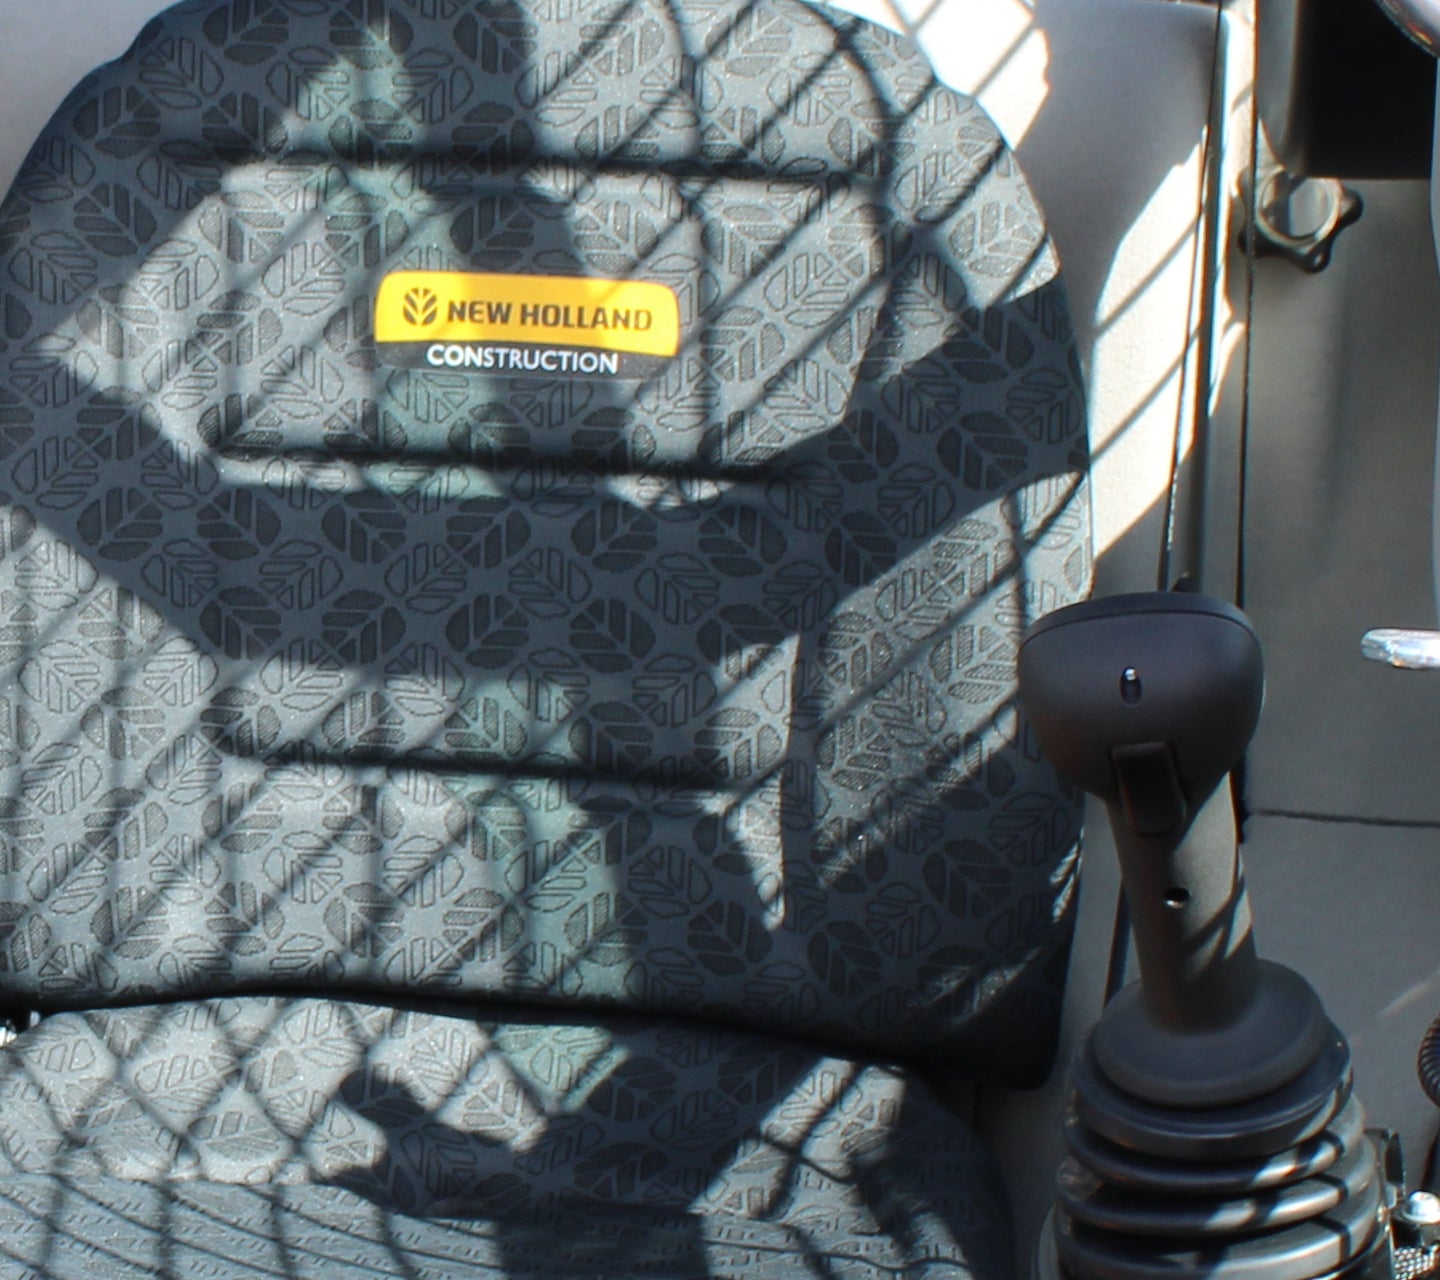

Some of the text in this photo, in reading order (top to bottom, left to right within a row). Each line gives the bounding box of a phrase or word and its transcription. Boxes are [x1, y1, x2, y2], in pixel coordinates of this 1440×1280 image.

[447, 299, 652, 332] NEW HOLLAND
[426, 343, 618, 375] CONSTRUCTION
